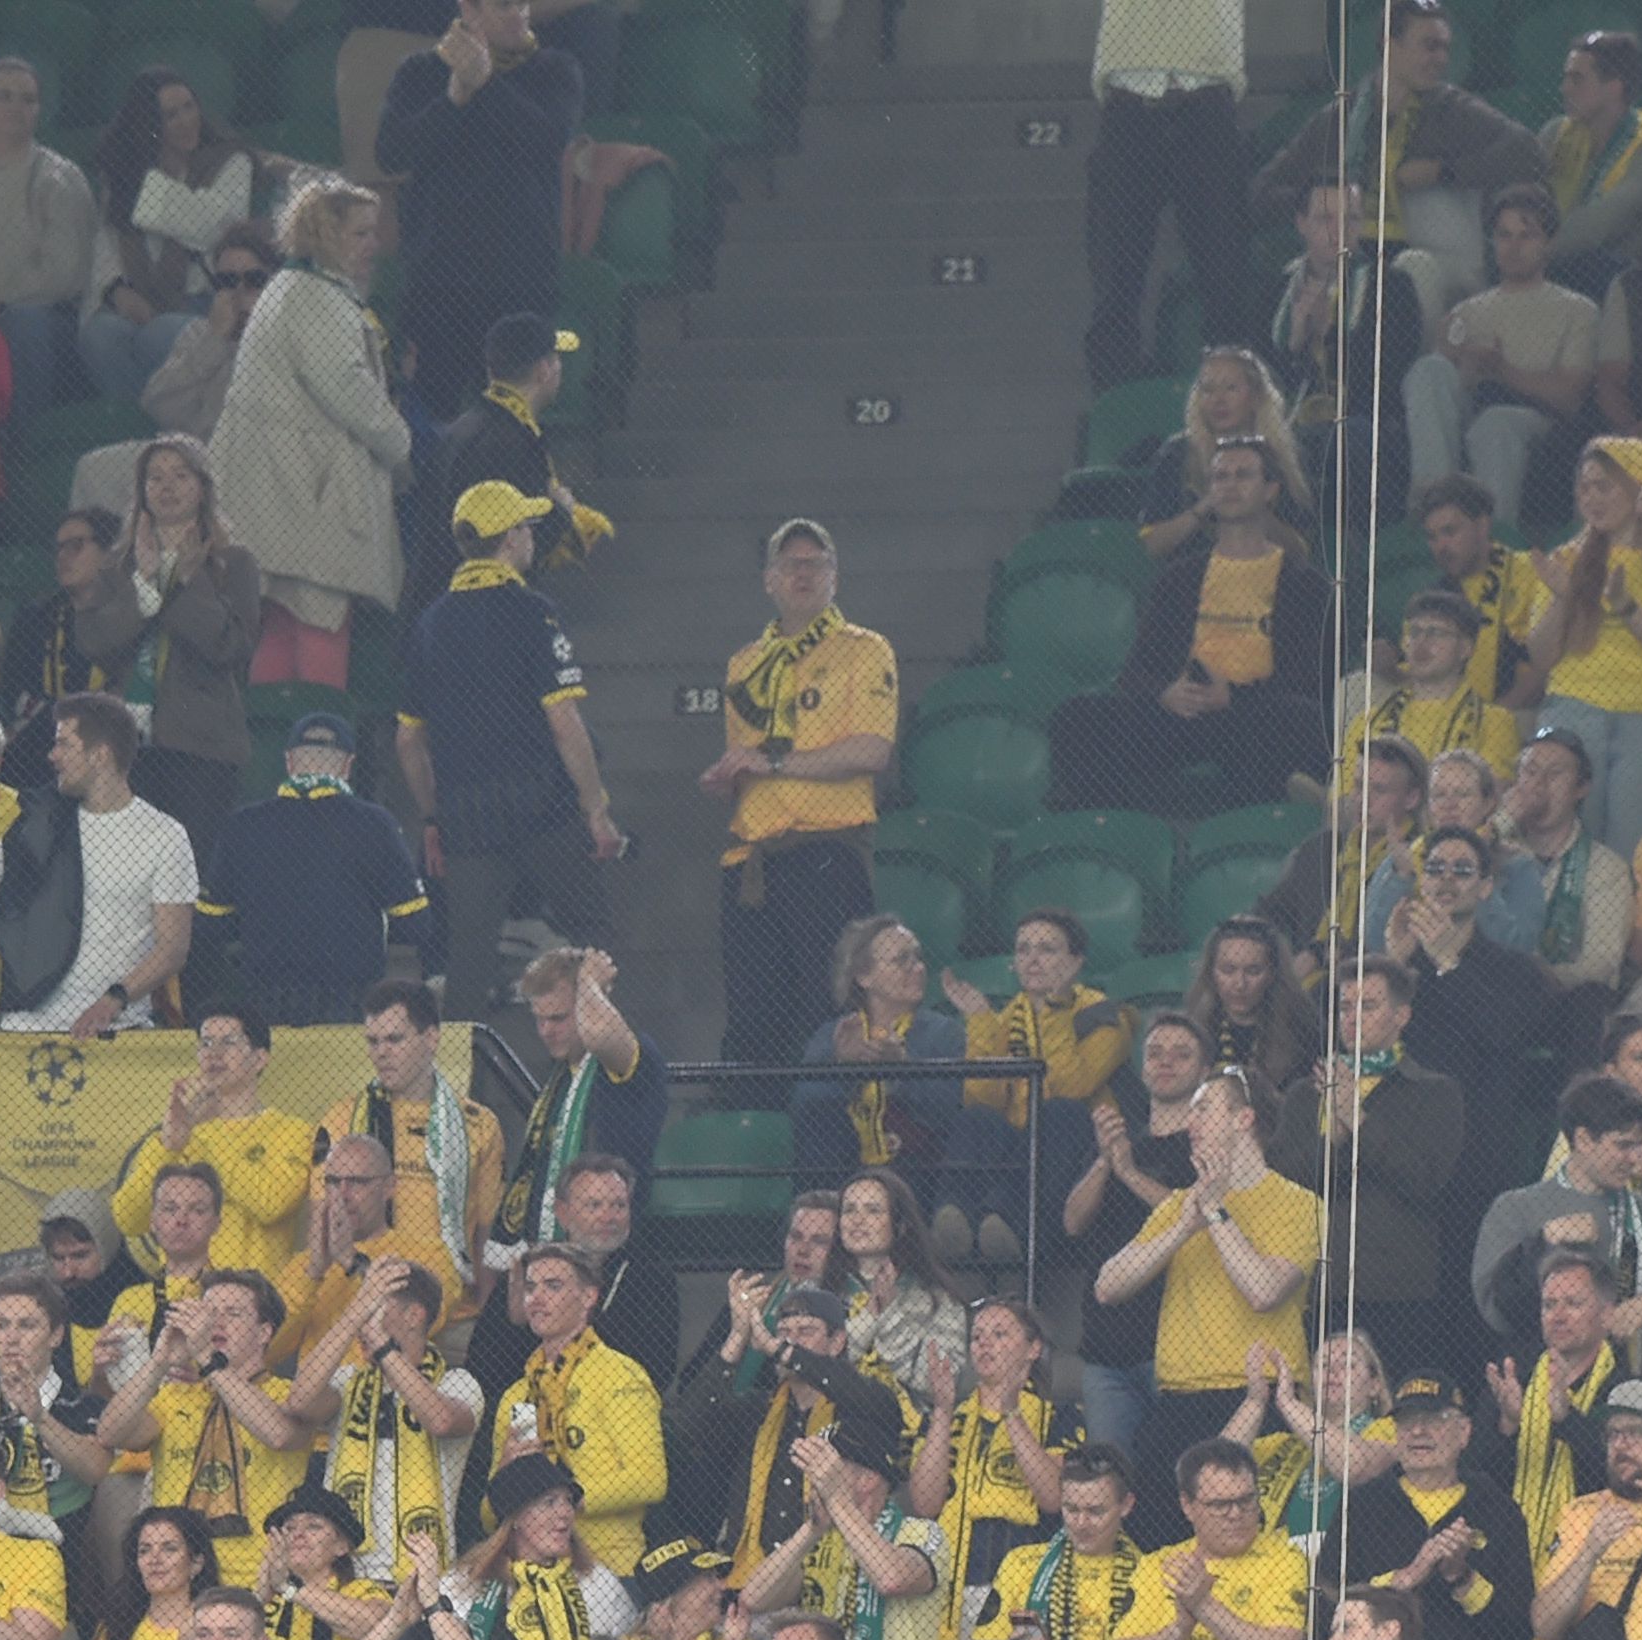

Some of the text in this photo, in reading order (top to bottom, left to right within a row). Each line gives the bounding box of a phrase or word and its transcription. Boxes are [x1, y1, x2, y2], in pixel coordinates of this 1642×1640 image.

[1028, 120, 1061, 146] 22
[941, 255, 976, 282] 21
[855, 398, 892, 424] 20
[684, 688, 719, 714] 18
[36, 1121, 75, 1137] UEFA
[11, 1137, 97, 1151] CHAMPIONS
[23, 1154, 80, 1170] LEAGUE
